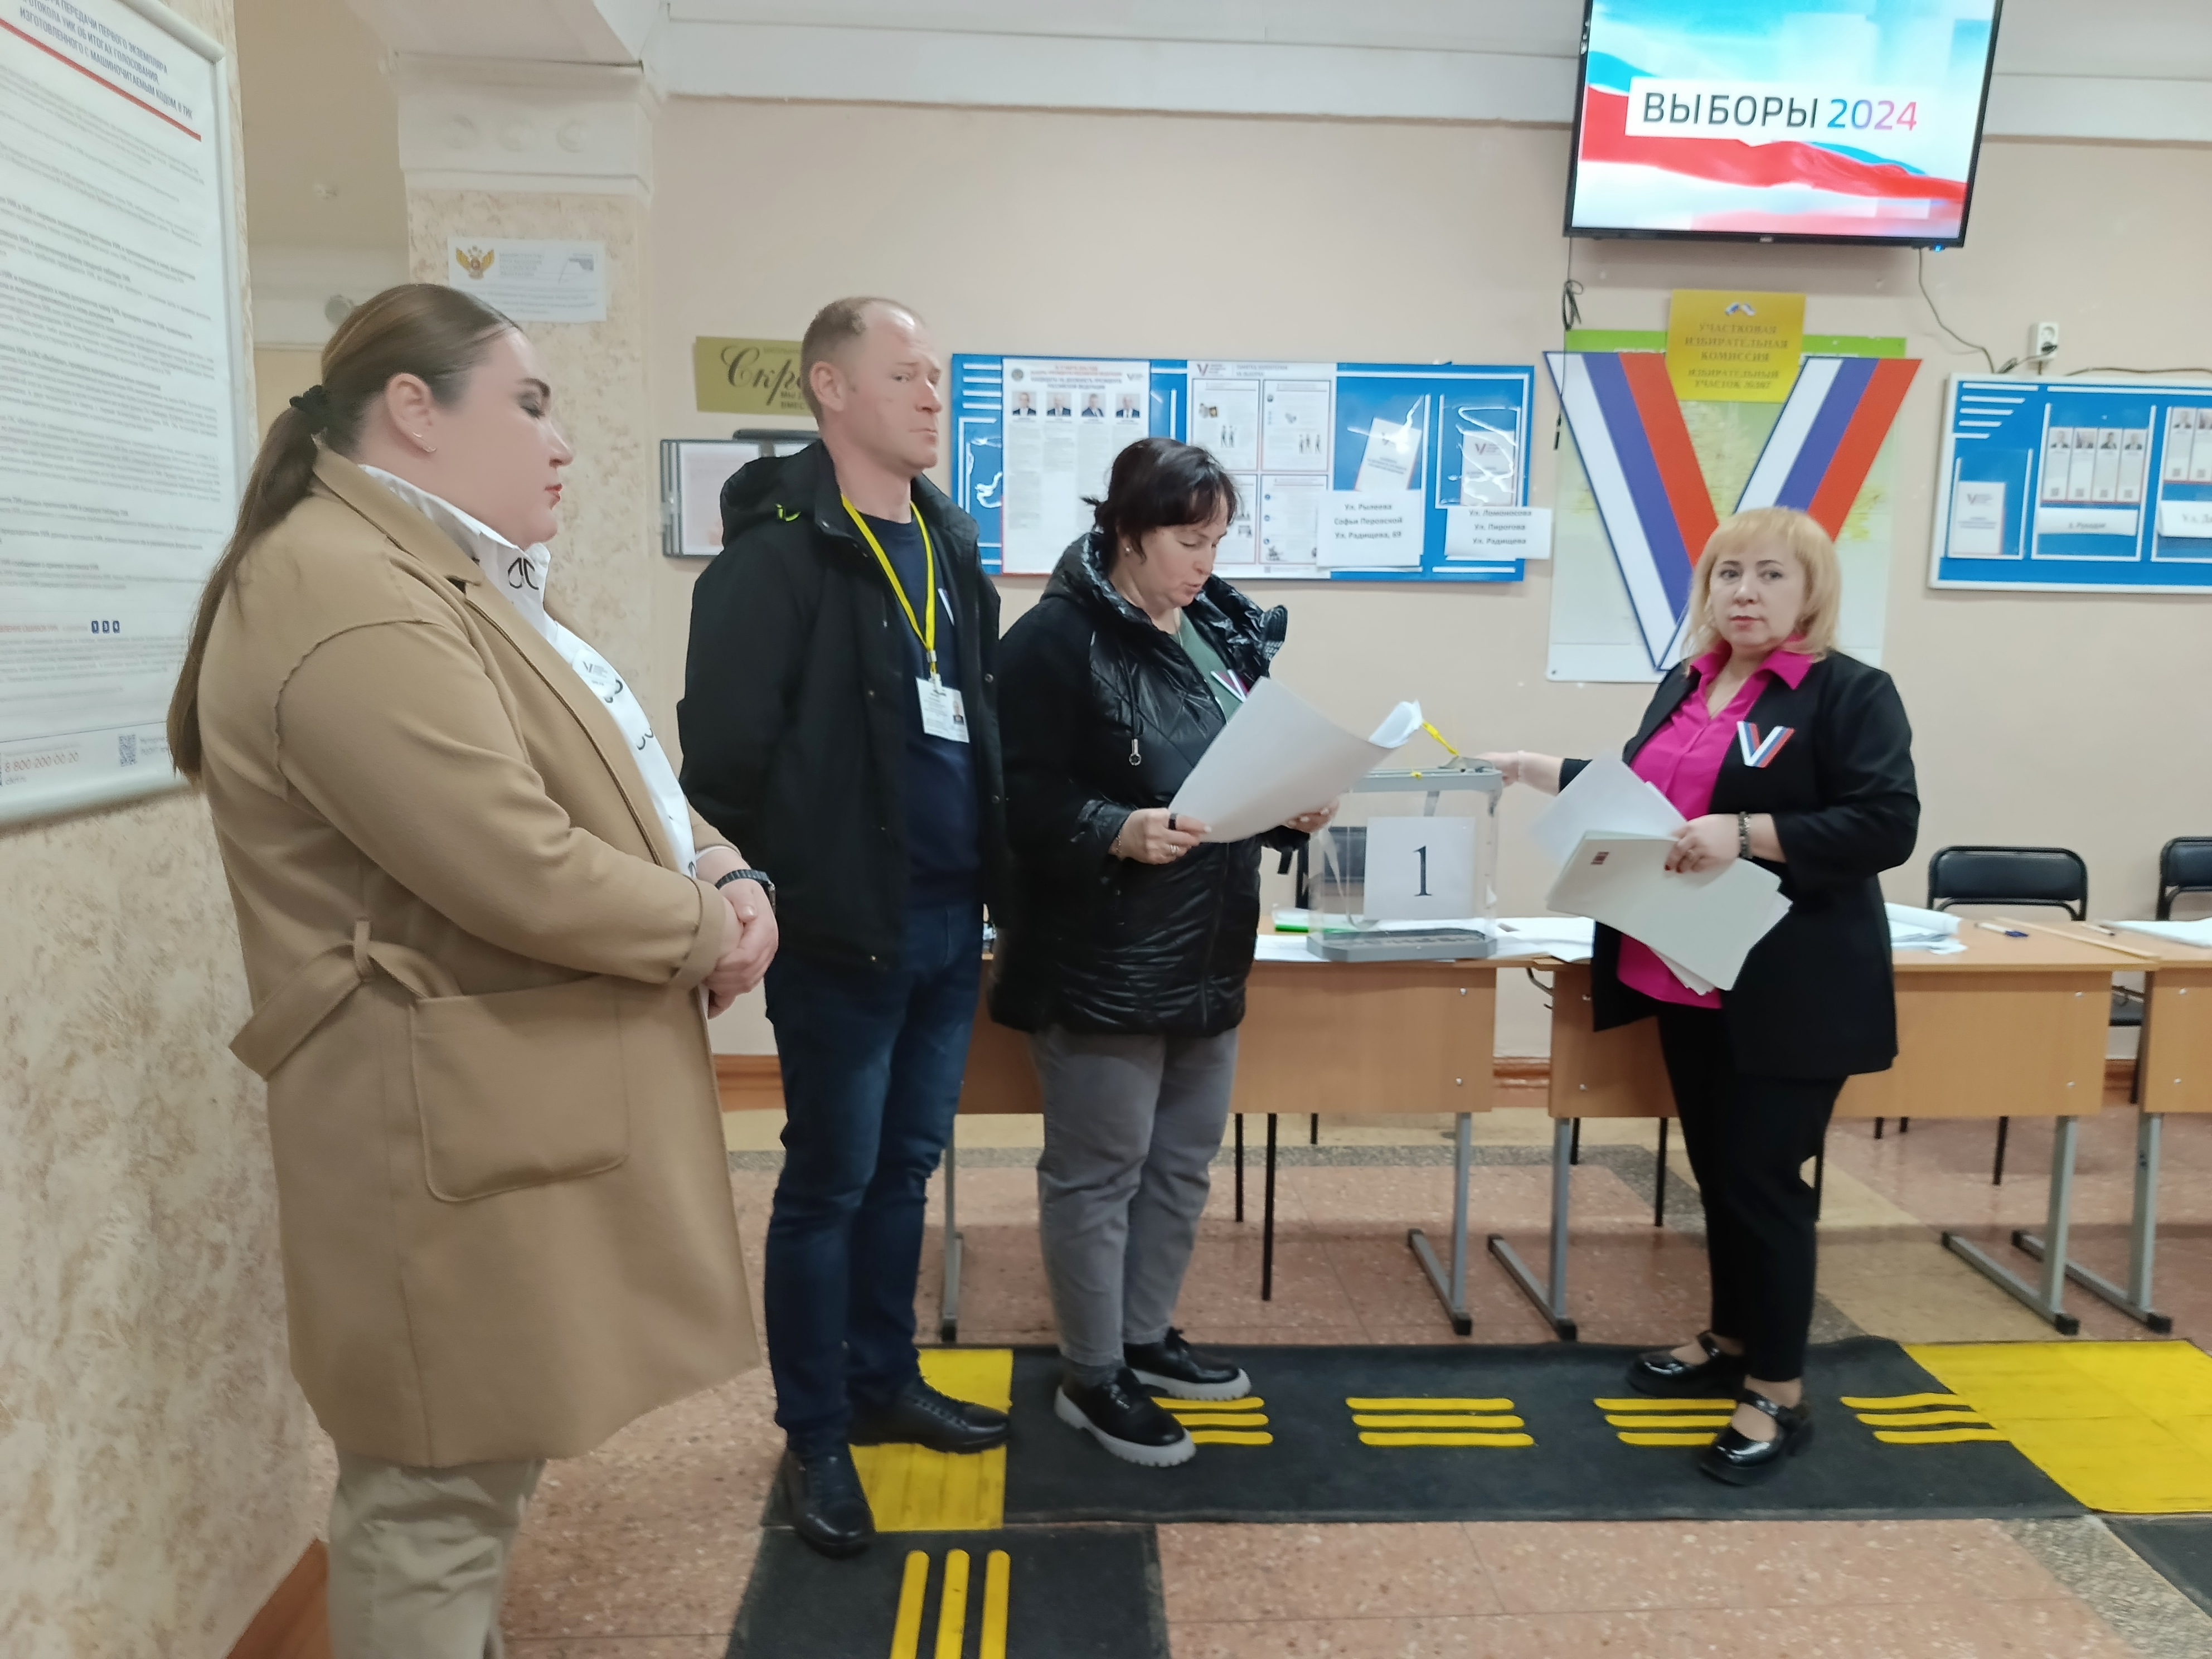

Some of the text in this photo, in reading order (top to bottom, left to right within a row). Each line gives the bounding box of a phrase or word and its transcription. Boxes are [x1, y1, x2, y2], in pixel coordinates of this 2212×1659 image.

[88, 32, 113, 56] ИТОГАХ
[1642, 91, 1918, 131] ВЫБОРЫ 2024
[1413, 846, 1432, 896] 1
